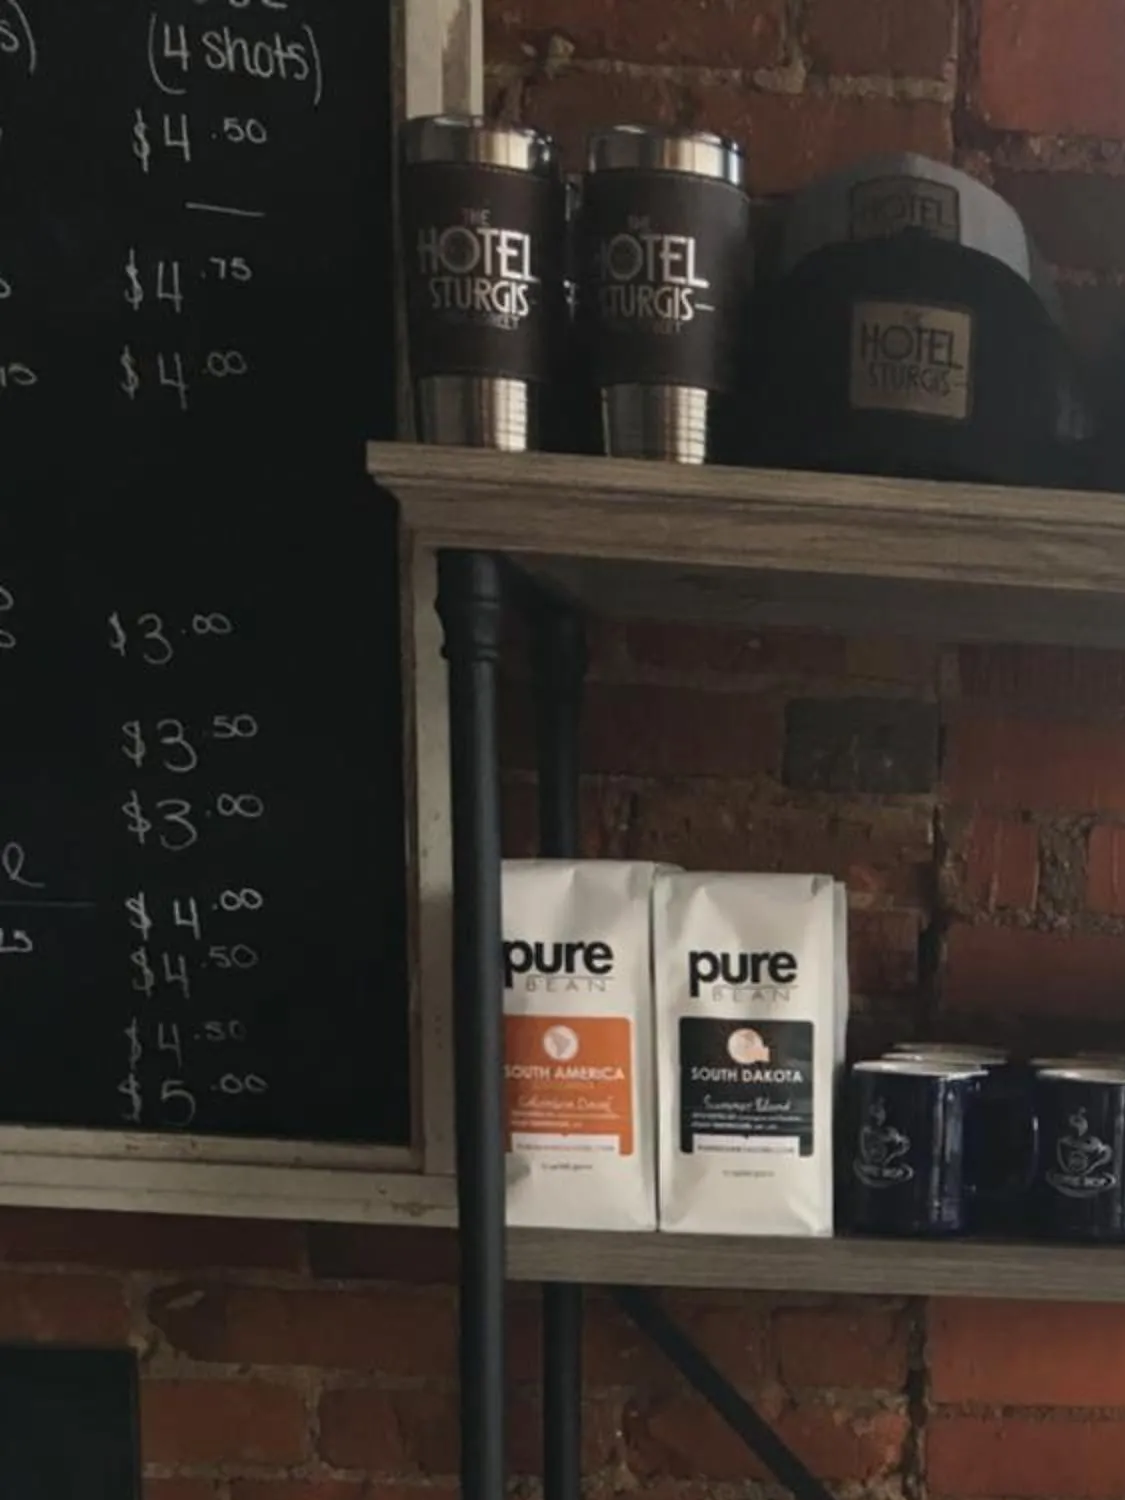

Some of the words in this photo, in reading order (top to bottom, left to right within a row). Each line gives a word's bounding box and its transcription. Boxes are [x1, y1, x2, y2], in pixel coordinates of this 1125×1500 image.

[417, 224, 541, 283] HOTEL
[429, 275, 530, 317] STURGIS
[860, 322, 964, 370] HOTEL
[868, 361, 951, 398] STURGIS
[502, 939, 614, 989] pure
[688, 949, 798, 998] pure
[502, 1064, 551, 1080] SOUTH
[553, 1064, 625, 1082] AMERICA
[690, 1067, 738, 1082] SOUTH
[741, 1068, 804, 1084] DAKOTA
